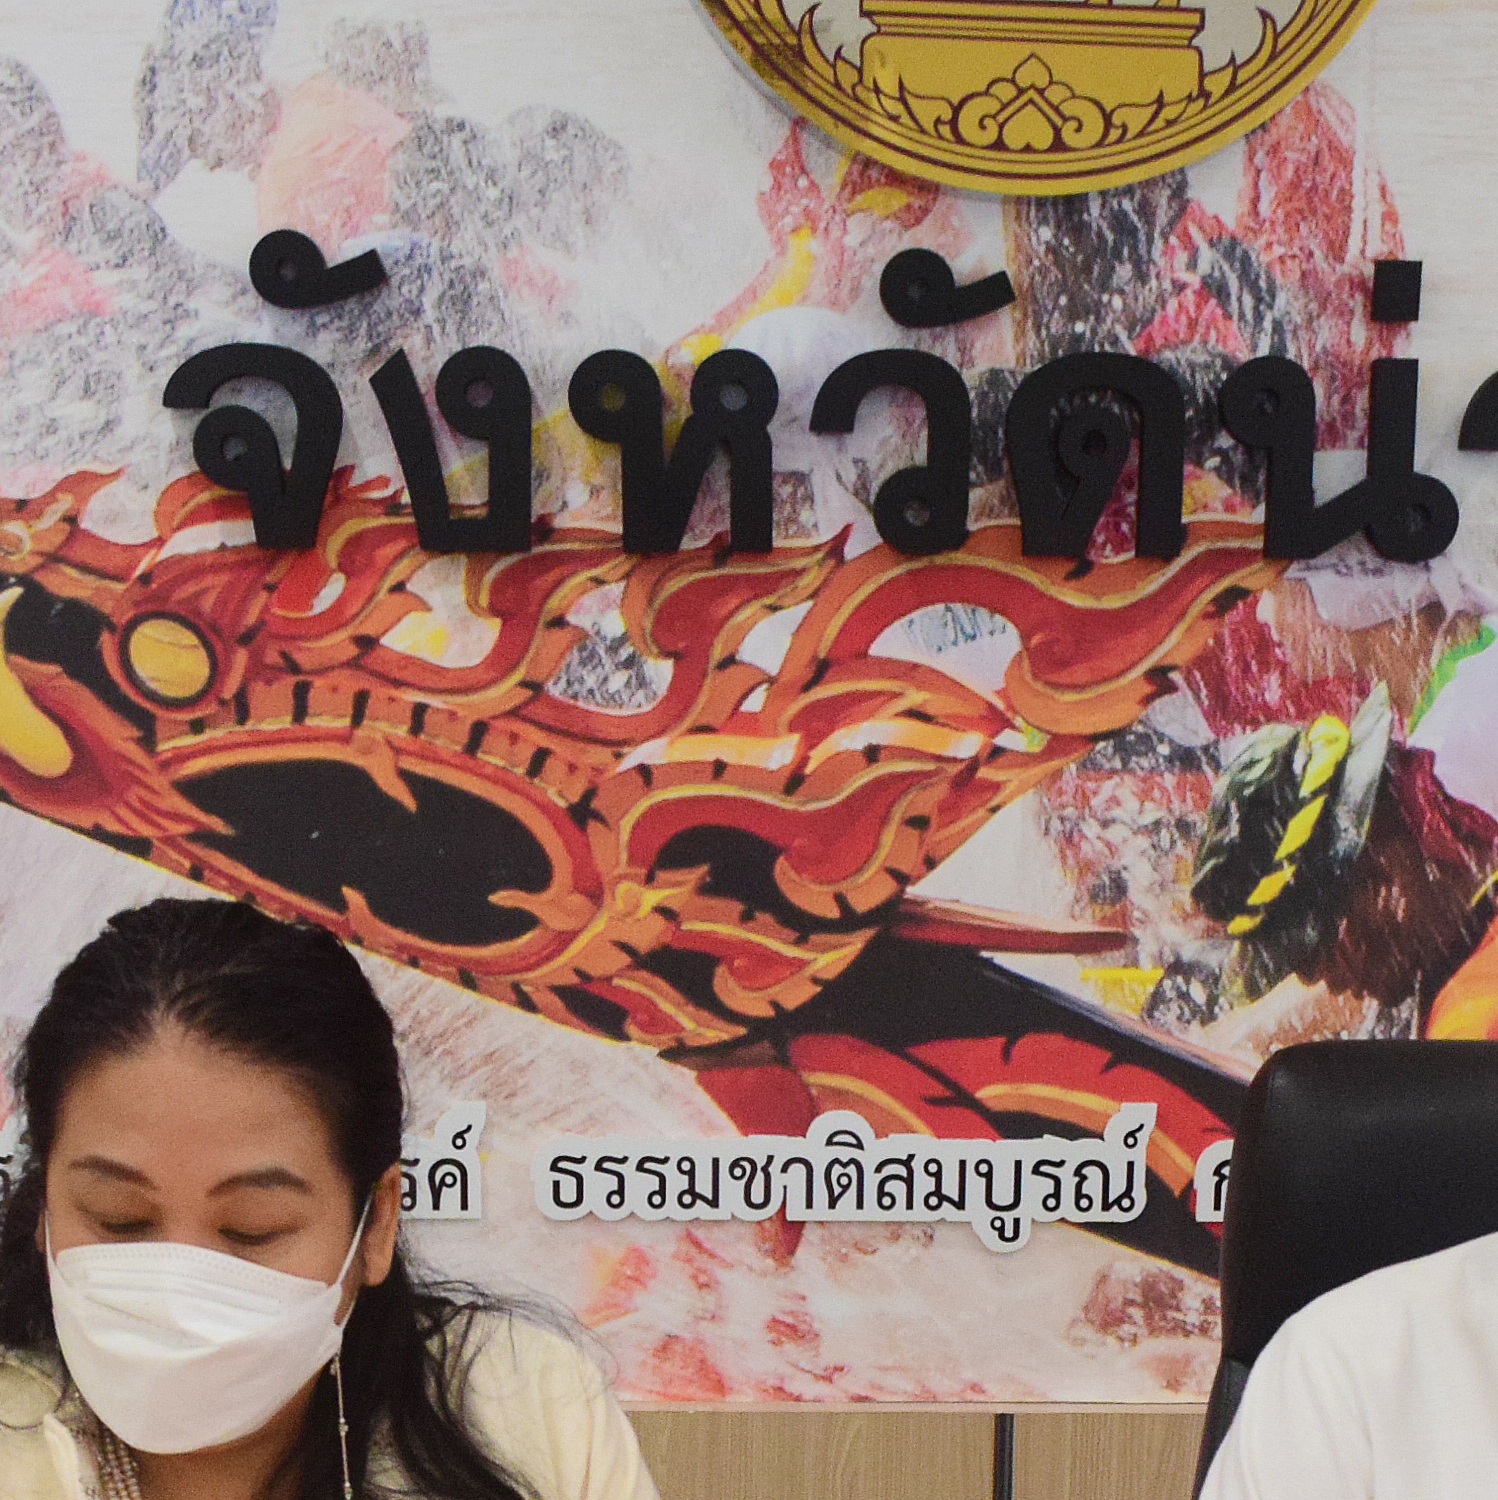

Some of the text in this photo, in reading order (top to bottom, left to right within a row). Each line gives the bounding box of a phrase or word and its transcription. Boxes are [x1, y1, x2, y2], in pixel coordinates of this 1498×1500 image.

[548, 1122, 1145, 1242] ธรรมชาติสมบูรณ์
